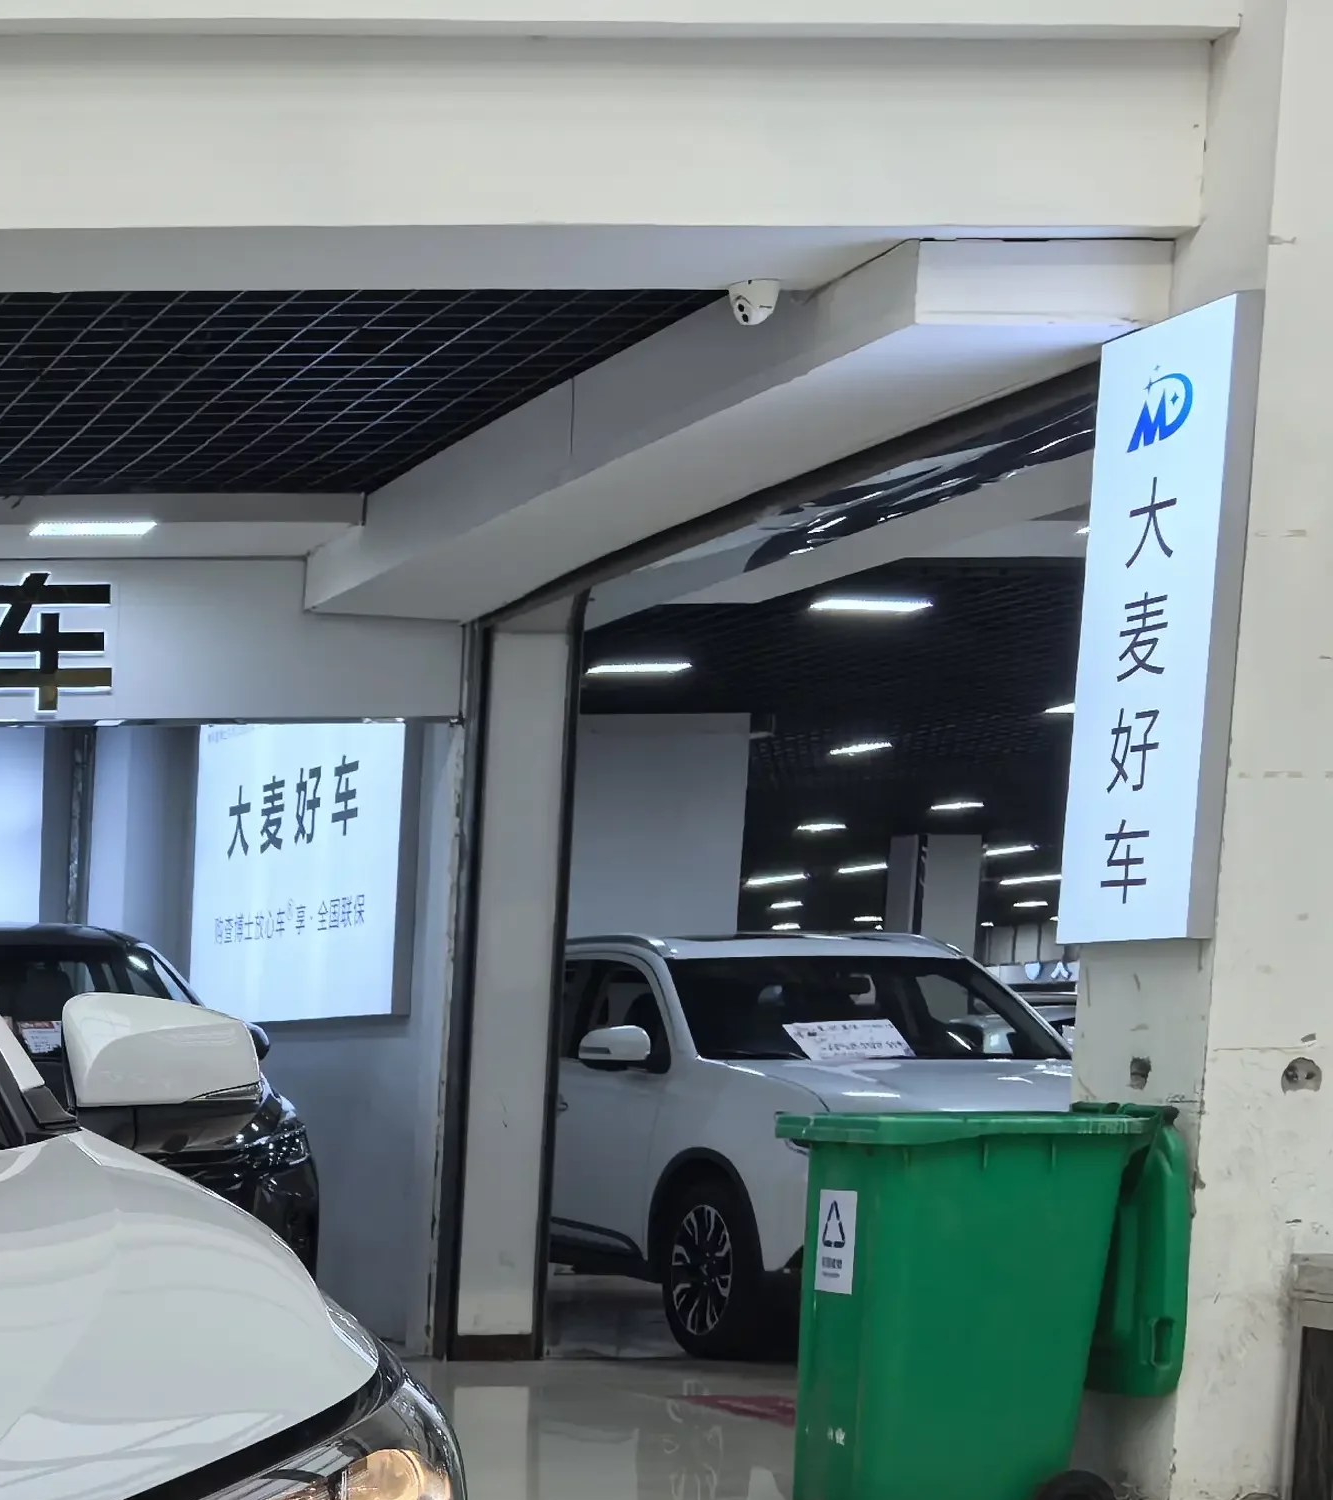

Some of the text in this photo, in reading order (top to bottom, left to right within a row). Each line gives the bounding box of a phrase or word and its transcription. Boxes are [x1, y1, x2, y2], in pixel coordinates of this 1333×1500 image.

[227, 755, 359, 860] 大麦好车
[1100, 477, 1178, 904] 大麦好车
